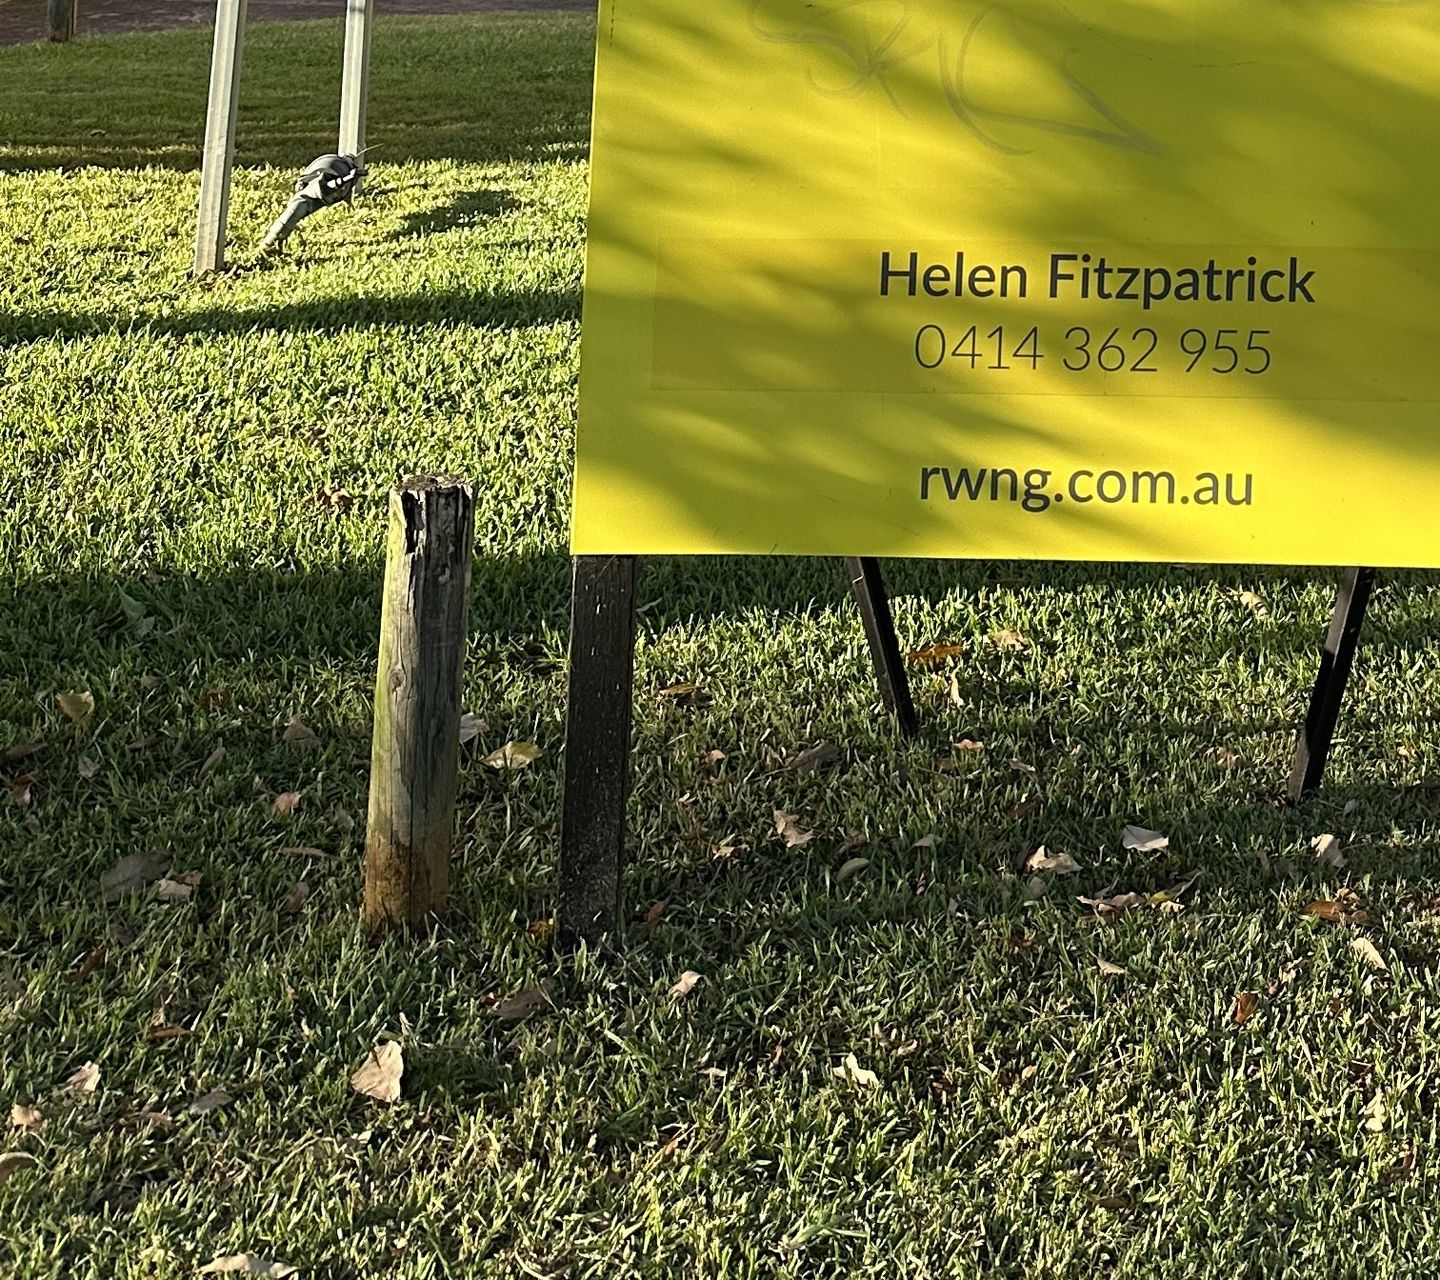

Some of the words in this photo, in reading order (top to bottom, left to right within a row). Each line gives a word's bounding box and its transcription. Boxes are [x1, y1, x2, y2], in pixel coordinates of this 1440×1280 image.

[879, 252, 1028, 298] Helen
[1048, 253, 1316, 310] Fitzpatrick
[914, 324, 1044, 372] 0414
[1062, 326, 1158, 373] 362
[1179, 329, 1272, 375] 955
[920, 465, 1253, 512] rwng.com.au
